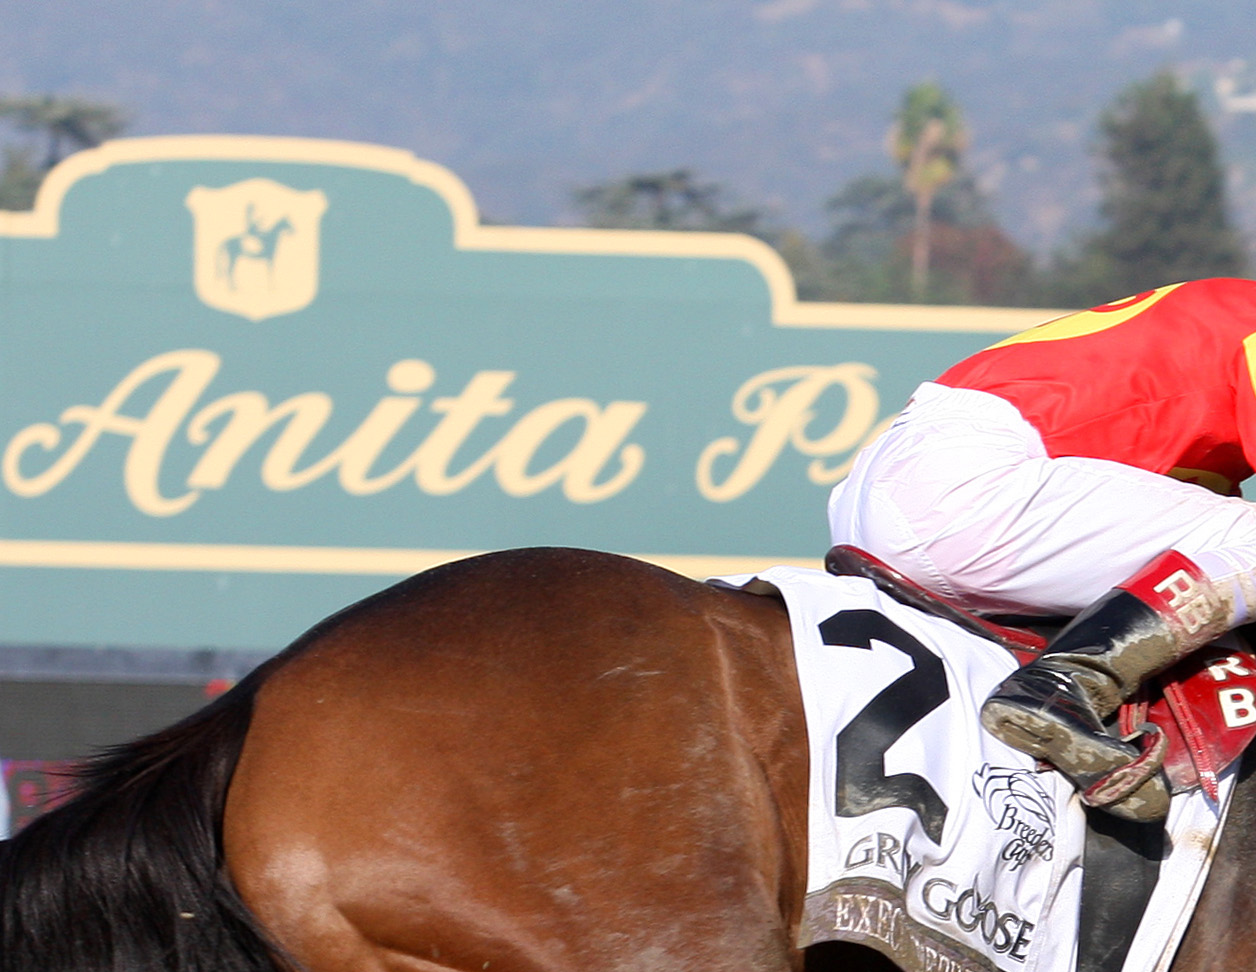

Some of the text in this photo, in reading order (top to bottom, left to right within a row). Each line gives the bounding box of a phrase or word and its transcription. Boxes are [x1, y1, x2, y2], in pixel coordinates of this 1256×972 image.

[2, 349, 901, 517] Anita P
[818, 609, 949, 847] 2
[844, 832, 1035, 964] GRY GOOSE
[1001, 838, 1031, 872] Cup
